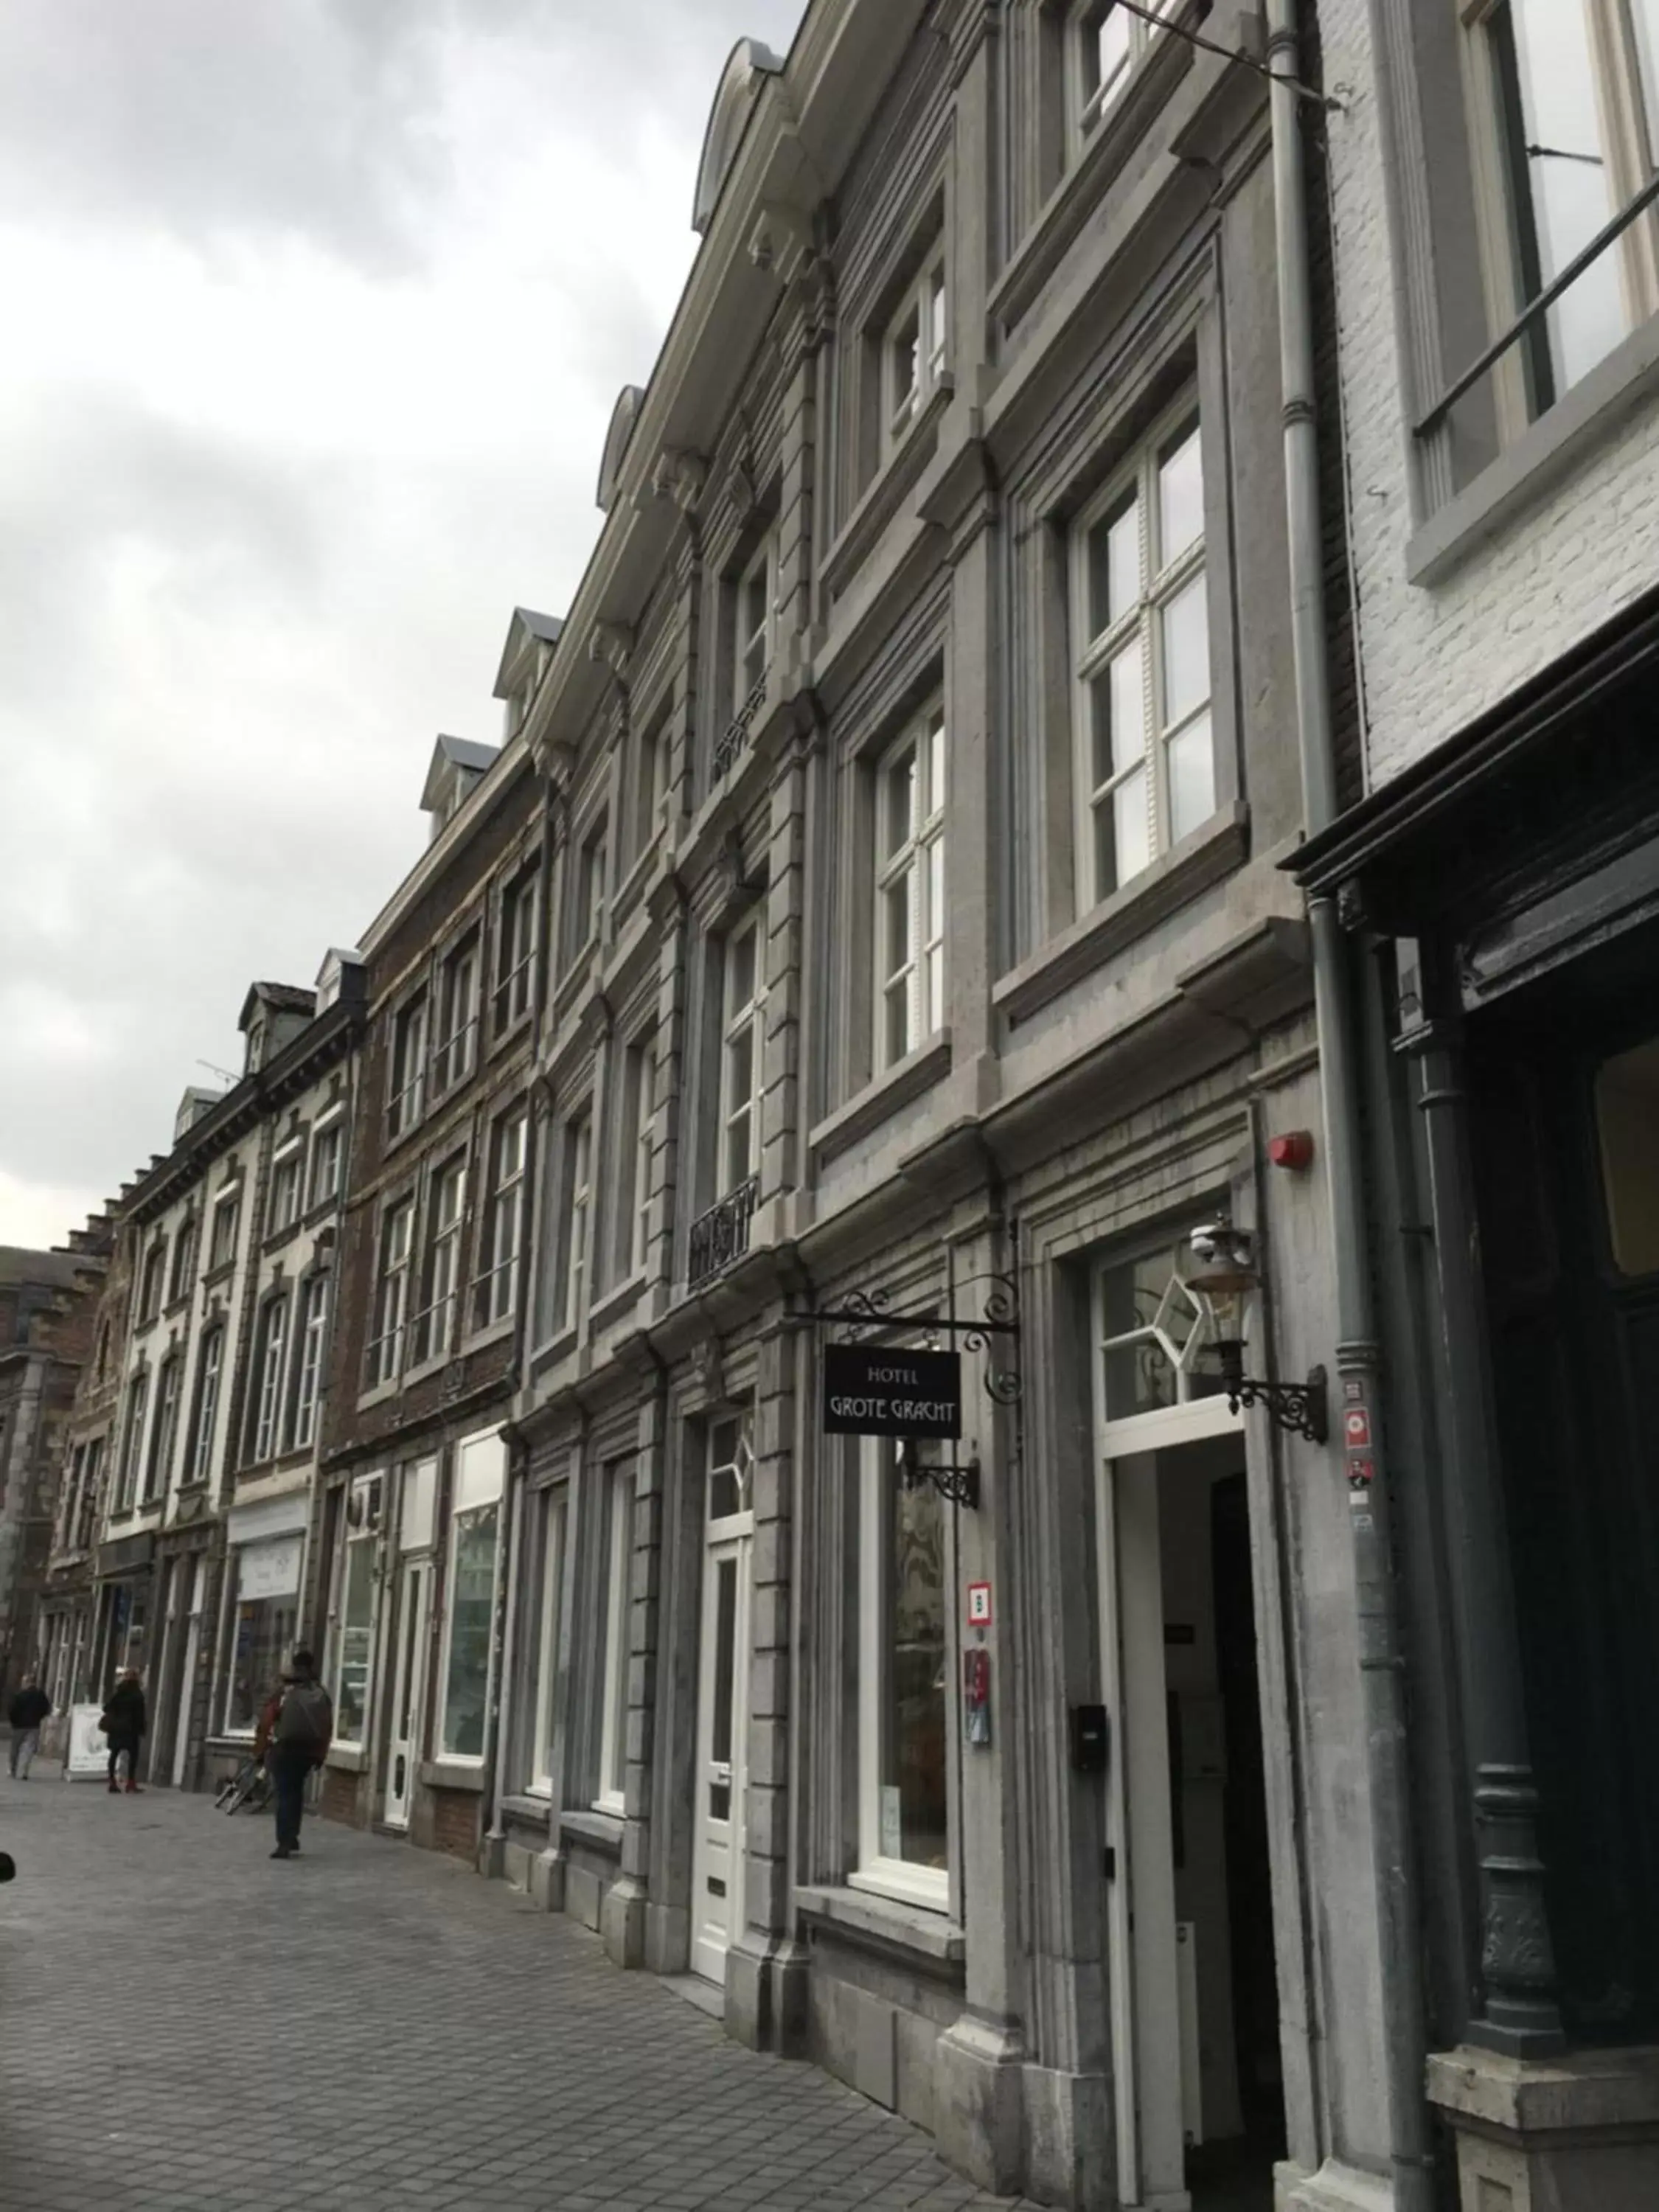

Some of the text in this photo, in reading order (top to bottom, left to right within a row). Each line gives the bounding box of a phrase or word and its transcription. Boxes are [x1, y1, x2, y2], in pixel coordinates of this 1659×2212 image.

[867, 1366, 919, 1385] HOTEL
[830, 1396, 956, 1422] GROTE GRACHT
